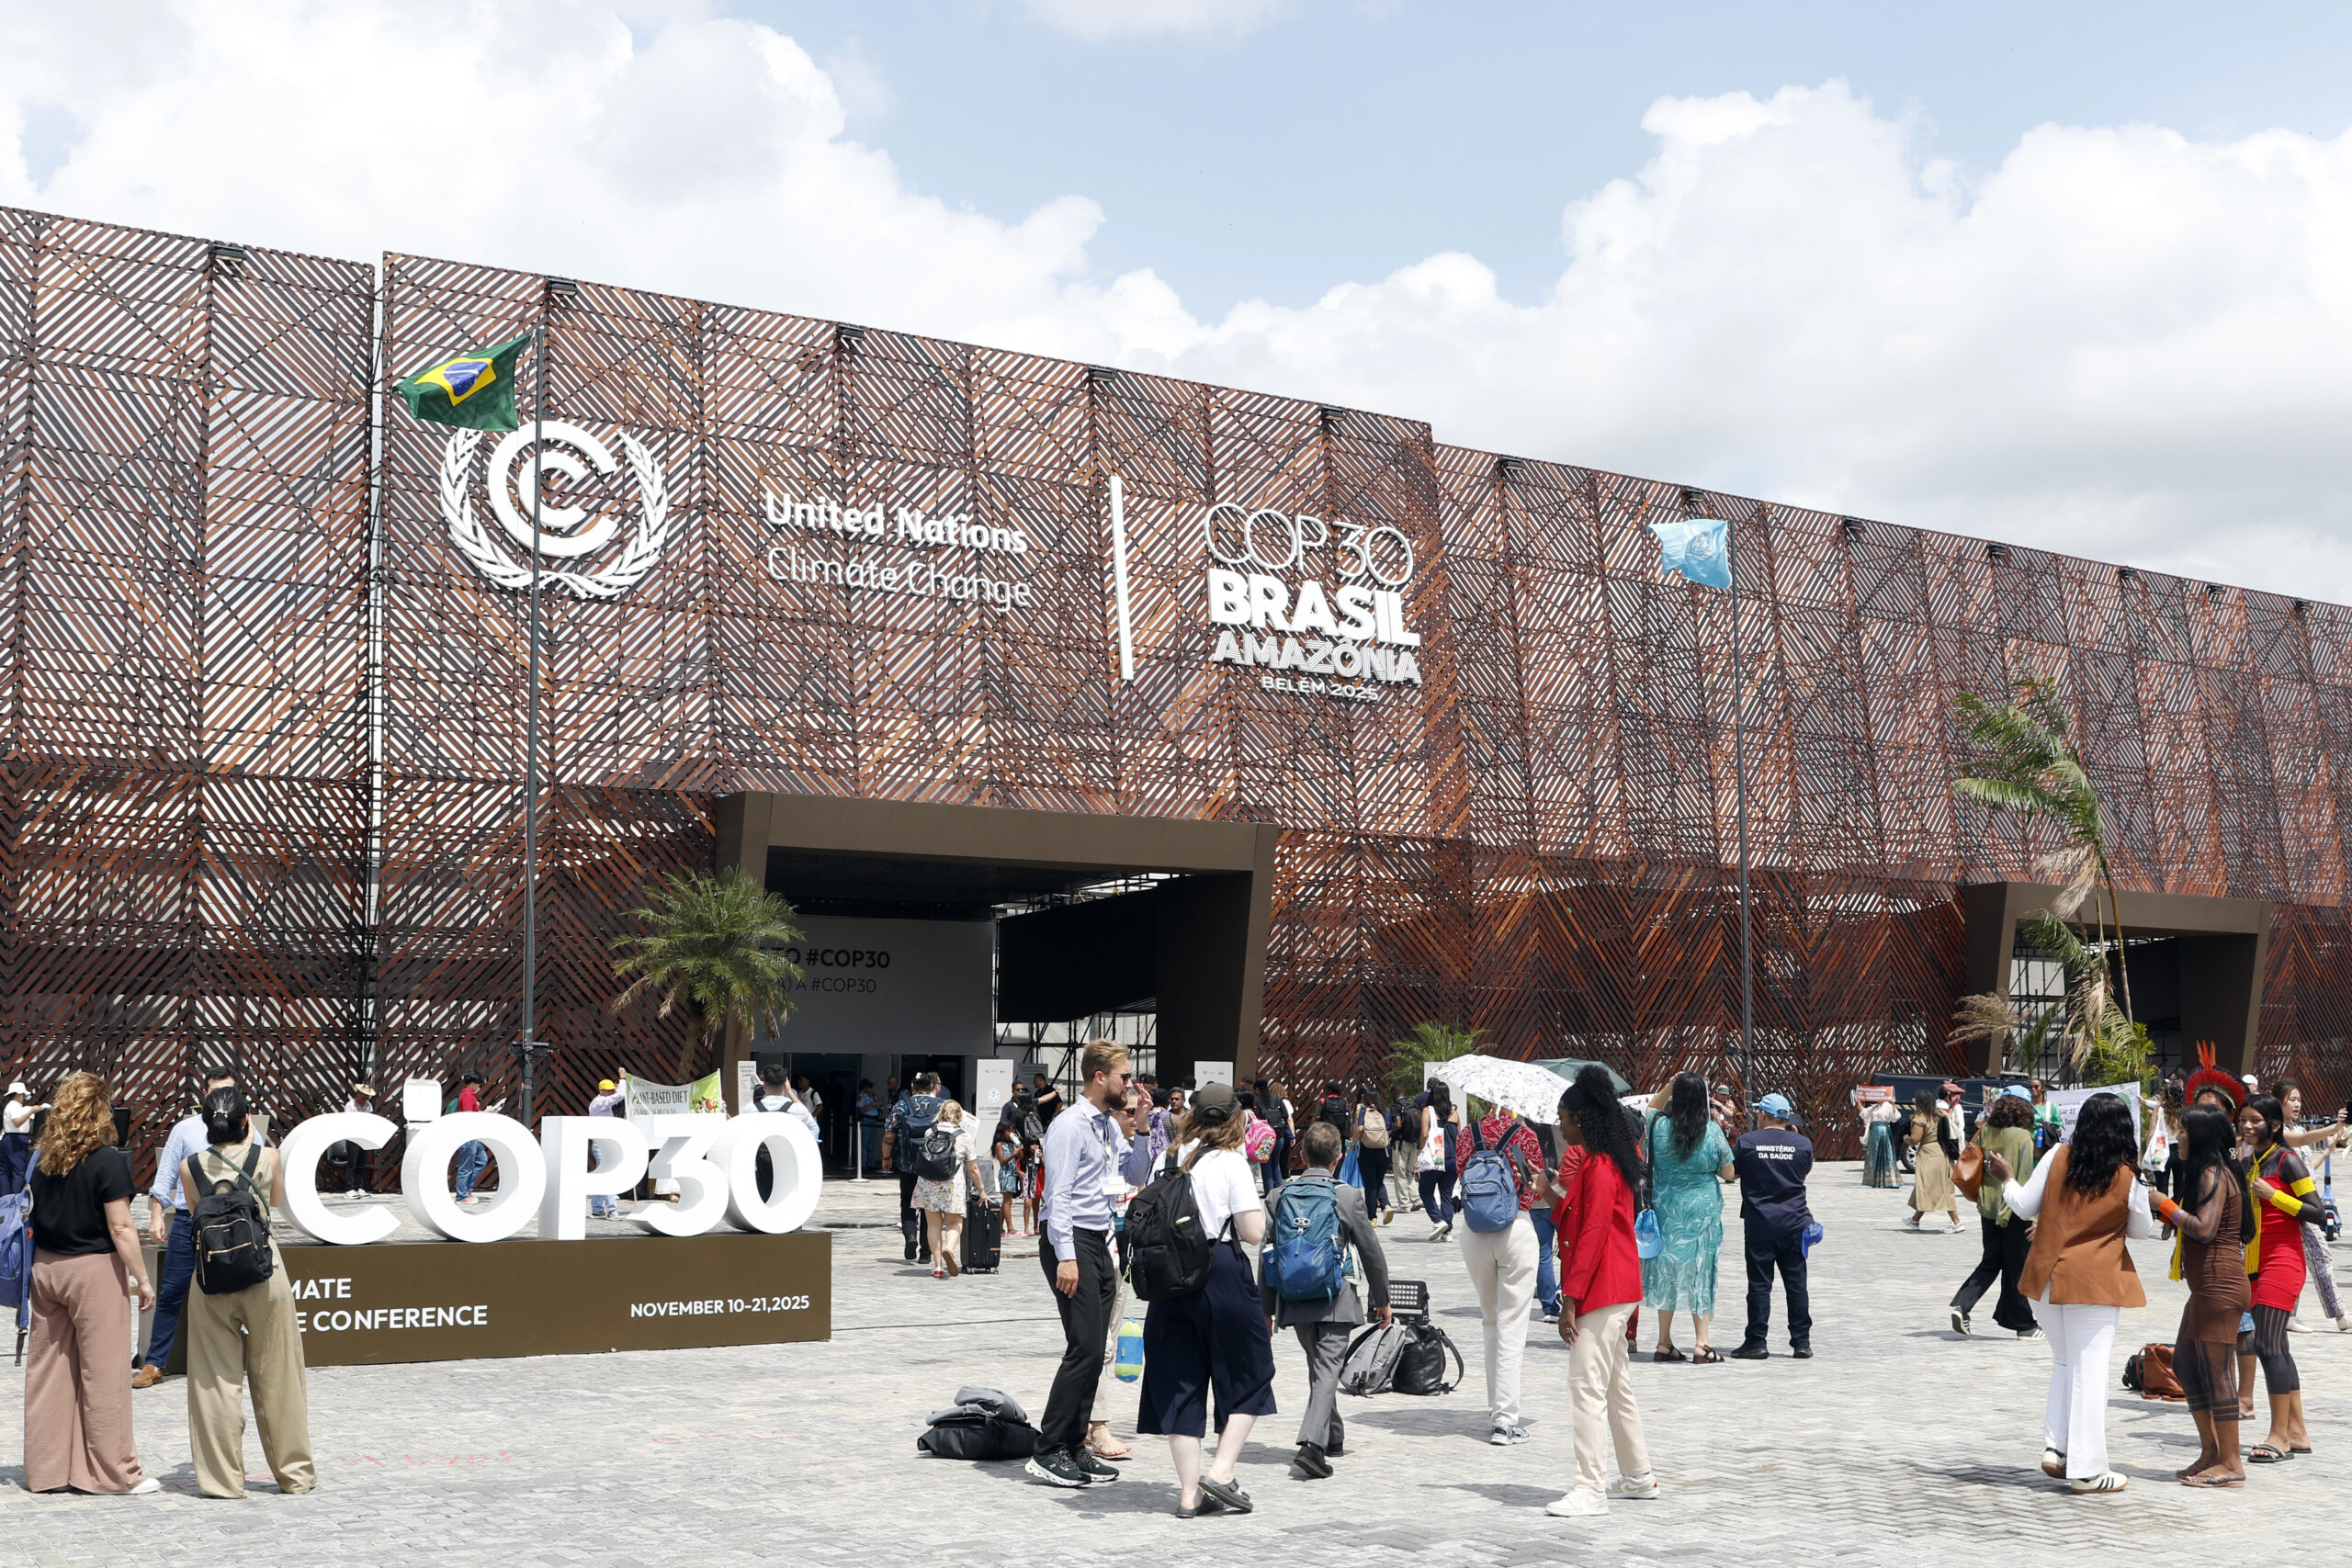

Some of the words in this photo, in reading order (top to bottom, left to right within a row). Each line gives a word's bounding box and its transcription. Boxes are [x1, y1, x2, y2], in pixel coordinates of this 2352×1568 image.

[765, 490, 885, 536] United
[896, 506, 1028, 554] Nations
[1204, 502, 1414, 587] COP30
[767, 547, 899, 593] Climate
[907, 561, 1032, 613] Change
[1206, 568, 1421, 647] BRASIL
[1212, 630, 1422, 685] AMAZÔNIA
[1261, 675, 1327, 695] BELÉM
[1329, 682, 1379, 701] 2025
[806, 948, 891, 969] #COP30
[811, 976, 877, 993] #COP30
[673, 1091, 687, 1103] DIET
[1756, 1145, 1795, 1153] MINISTÉRIO
[1770, 1152, 1793, 1160] SAÚDE
[278, 1111, 823, 1246] COP30
[288, 1277, 353, 1301] MATE
[312, 1304, 489, 1332] CONFERENCE
[630, 1300, 725, 1318] NOVEMBER
